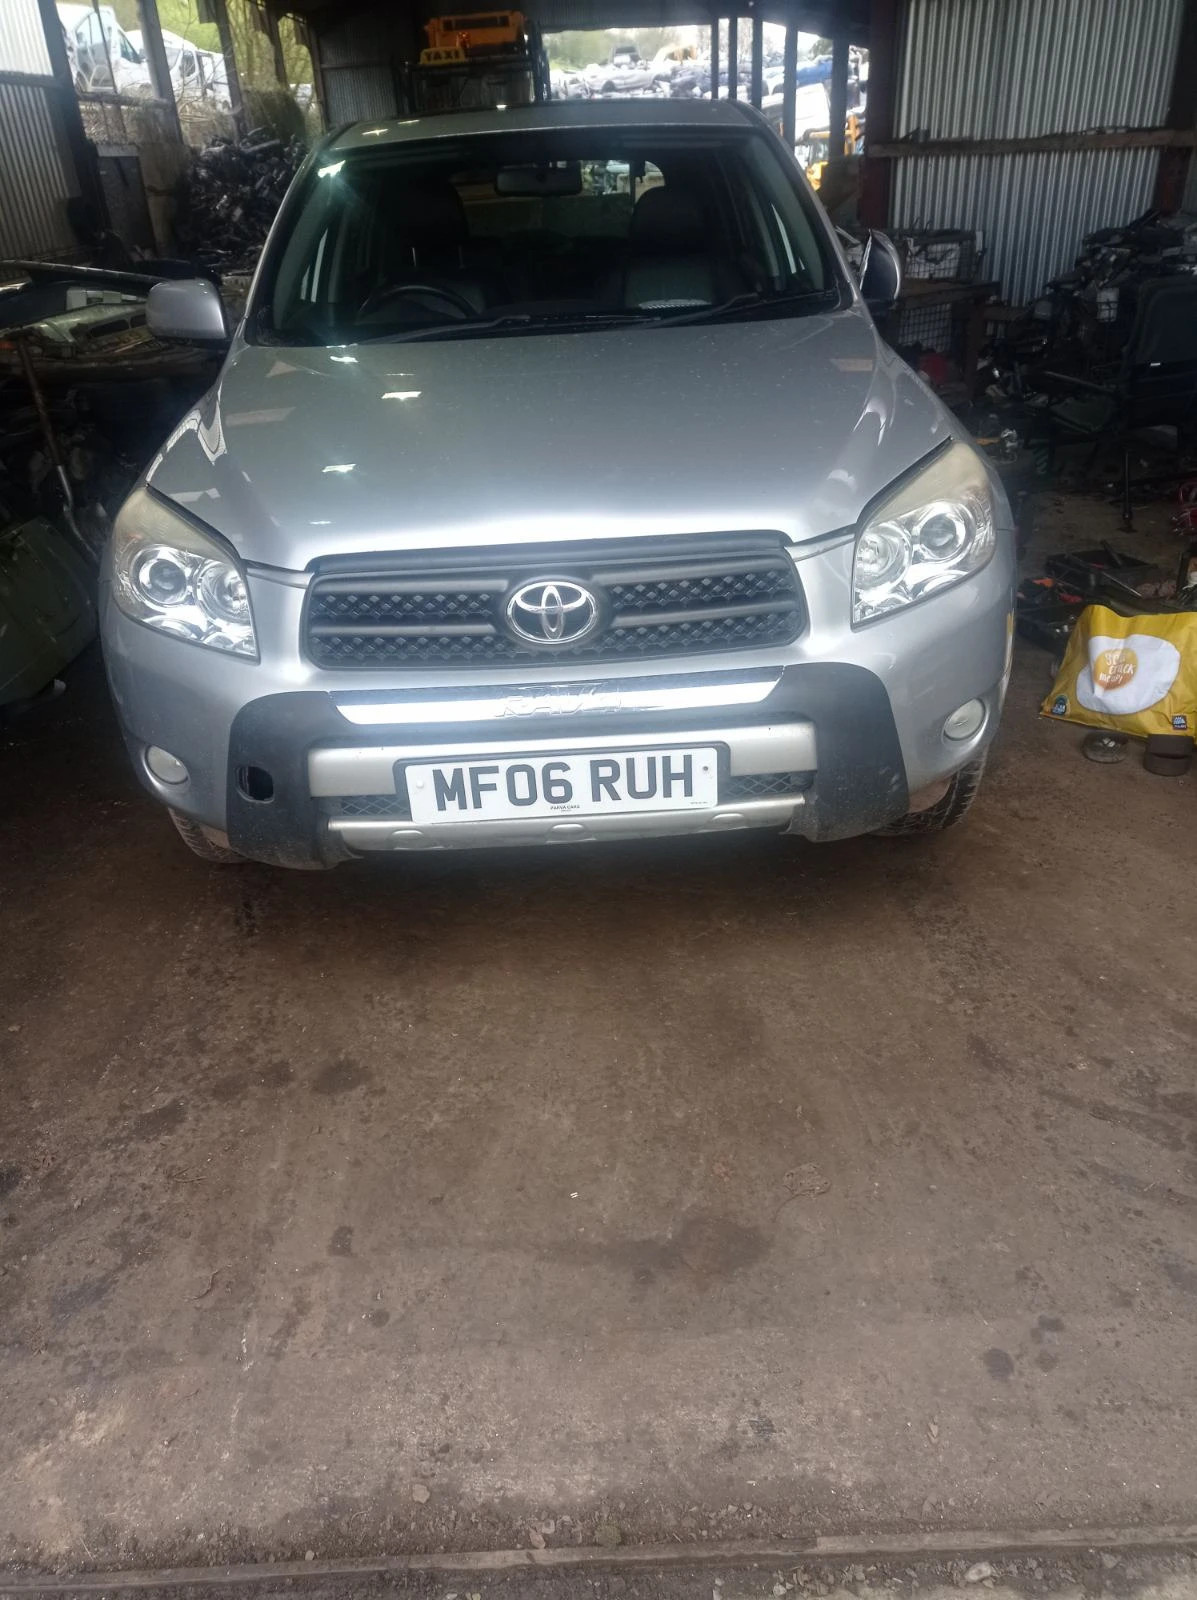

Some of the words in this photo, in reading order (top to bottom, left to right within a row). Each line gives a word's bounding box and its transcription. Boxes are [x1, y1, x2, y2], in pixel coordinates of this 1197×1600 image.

[424, 50, 460, 61] TAXI
[432, 761, 573, 811] MF06
[590, 754, 693, 803] RUH
